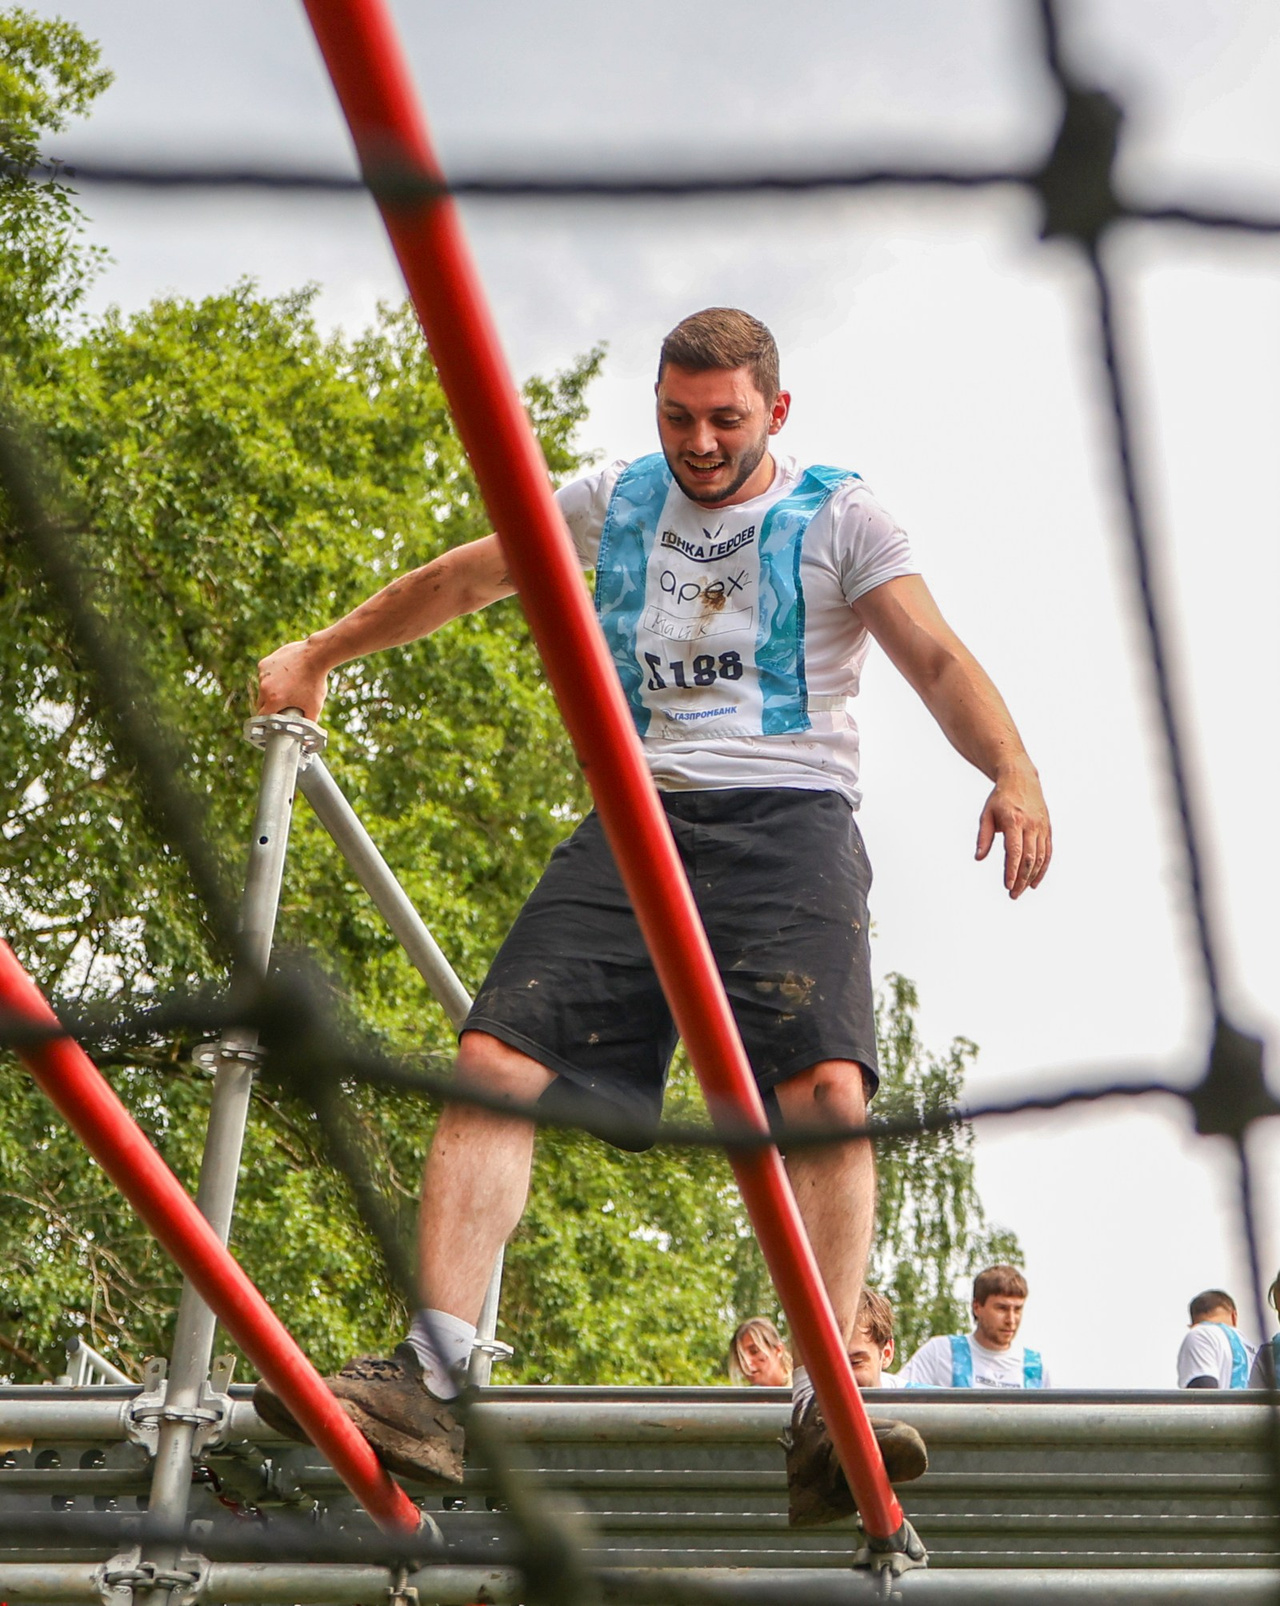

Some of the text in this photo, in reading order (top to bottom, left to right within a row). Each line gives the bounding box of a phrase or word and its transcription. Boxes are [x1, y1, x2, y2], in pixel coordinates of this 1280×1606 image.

[661, 525, 755, 558] ГОНКА ГЕРОЕВ
[659, 569, 746, 605] apex
[674, 706, 738, 721] ГАЗПРОМБАНК
